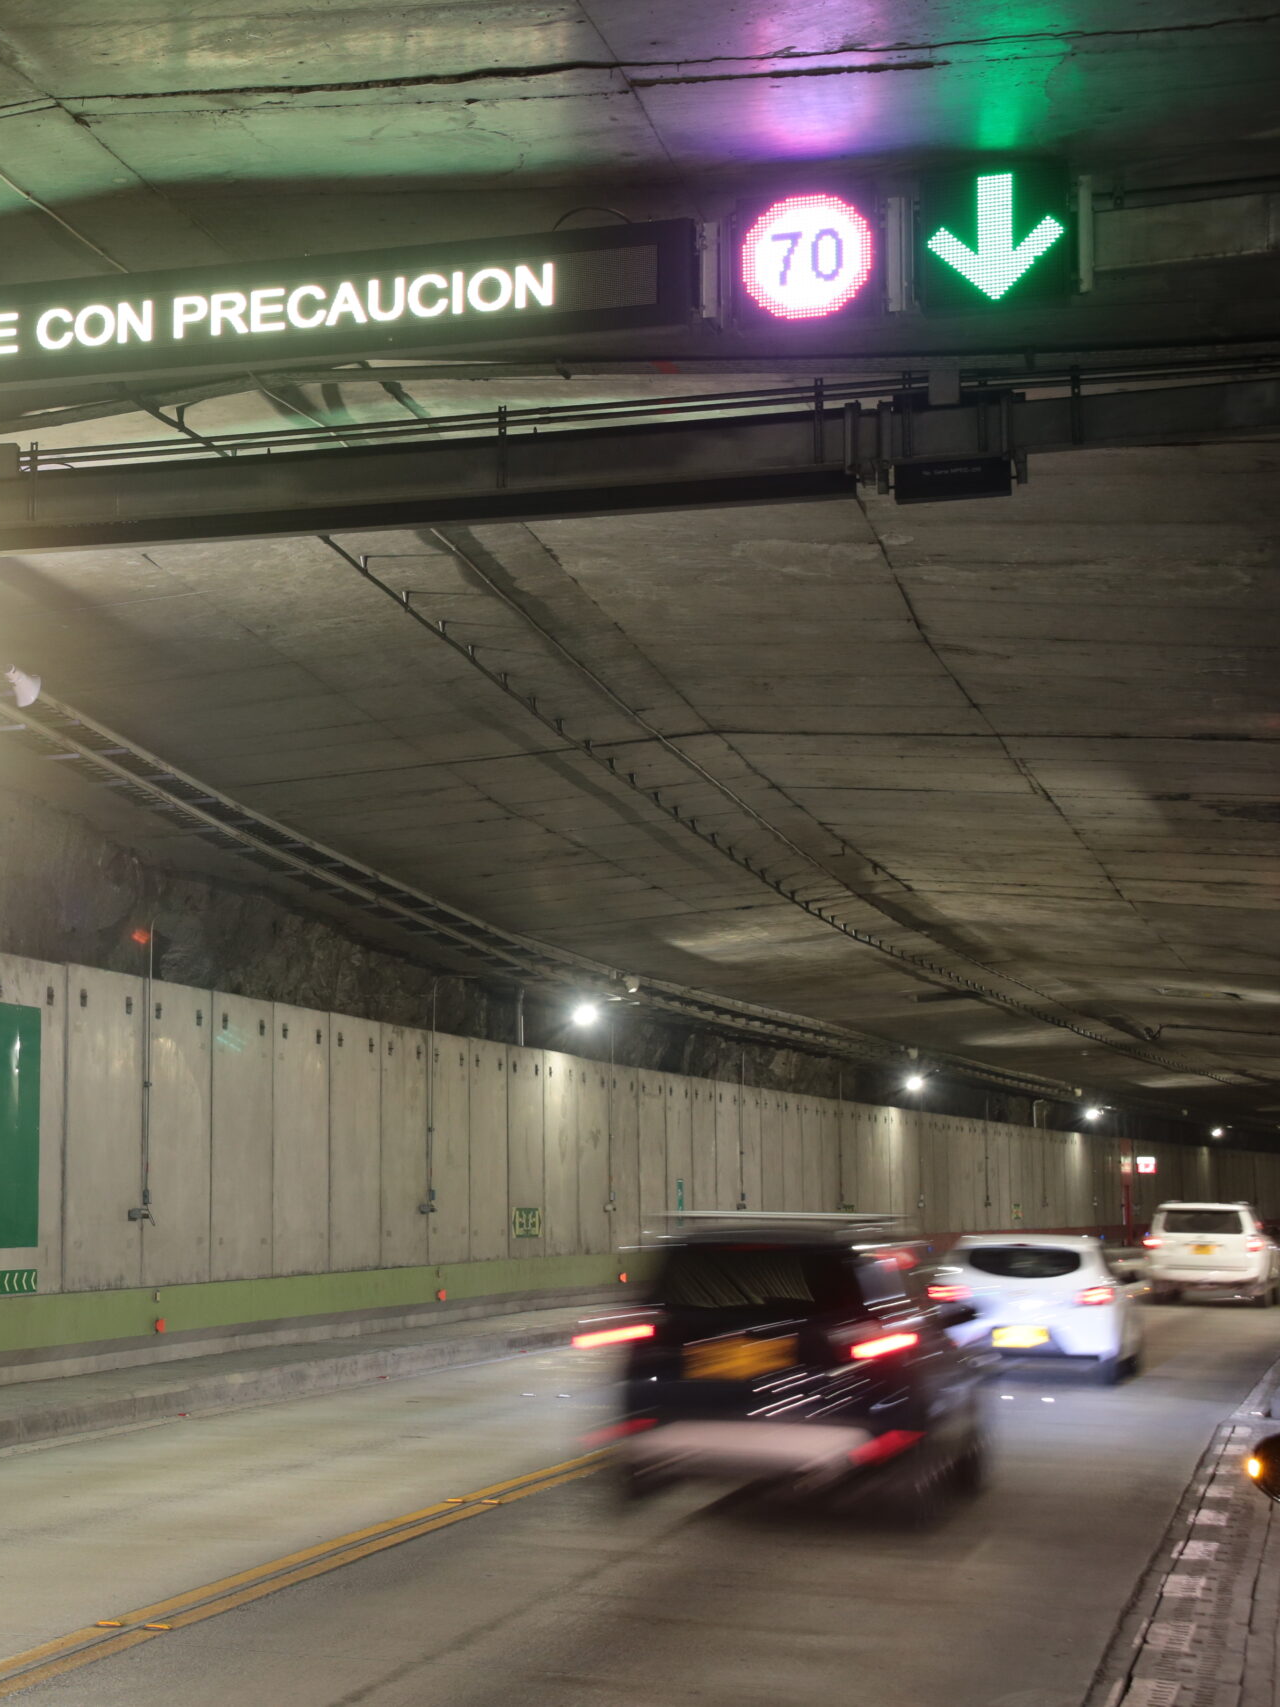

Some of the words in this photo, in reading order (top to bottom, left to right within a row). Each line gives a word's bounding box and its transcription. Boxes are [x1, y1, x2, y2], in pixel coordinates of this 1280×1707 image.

[771, 228, 843, 286] 70
[36, 300, 153, 350] CON
[172, 262, 554, 339] PRECAUCION
